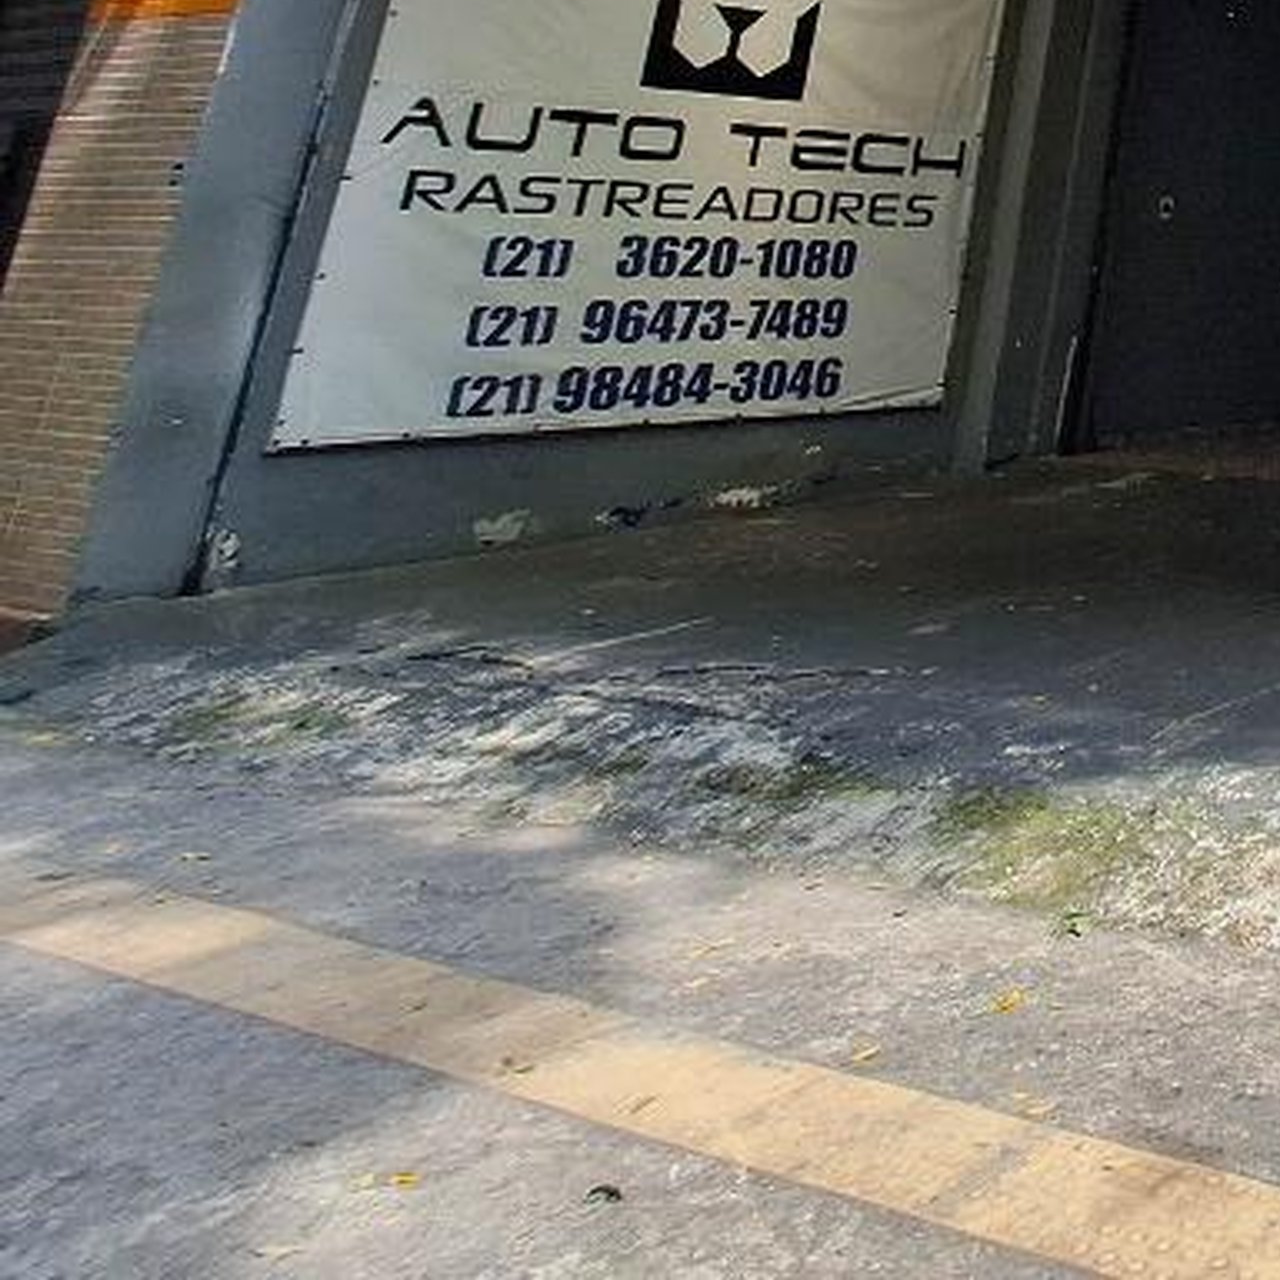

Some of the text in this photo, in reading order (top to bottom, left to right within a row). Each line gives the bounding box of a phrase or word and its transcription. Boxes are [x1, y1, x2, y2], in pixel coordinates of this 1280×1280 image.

[381, 96, 968, 180] AUTO TECH
[399, 169, 940, 229] RASTREADORES
[482, 235, 858, 280] (21) 3620-1080
[465, 297, 849, 348] (21) 96473-7489
[446, 357, 842, 418] (21) 98484-3046
